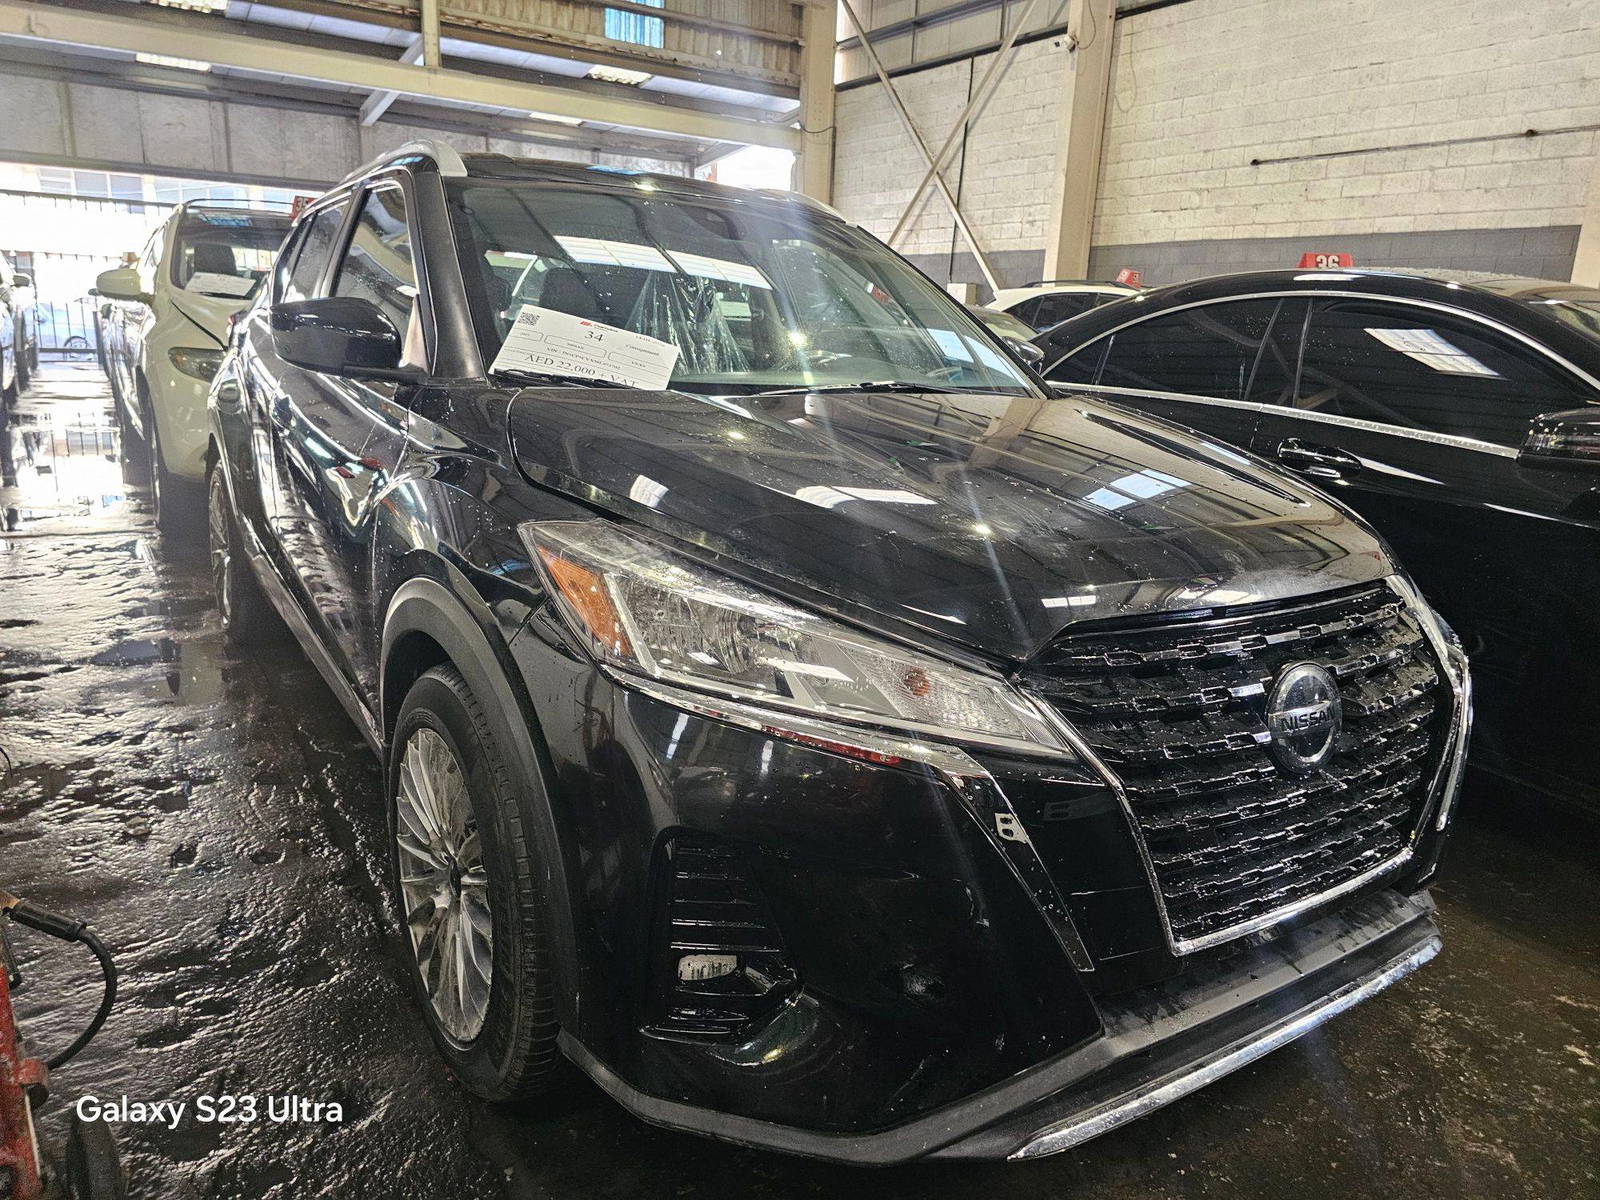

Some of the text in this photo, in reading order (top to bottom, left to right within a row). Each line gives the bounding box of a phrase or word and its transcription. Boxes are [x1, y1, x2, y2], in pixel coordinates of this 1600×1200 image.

[1316, 255, 1339, 268] 36
[584, 330, 603, 341] 34
[524, 354, 554, 366] AED
[1280, 707, 1336, 731] NISSAN
